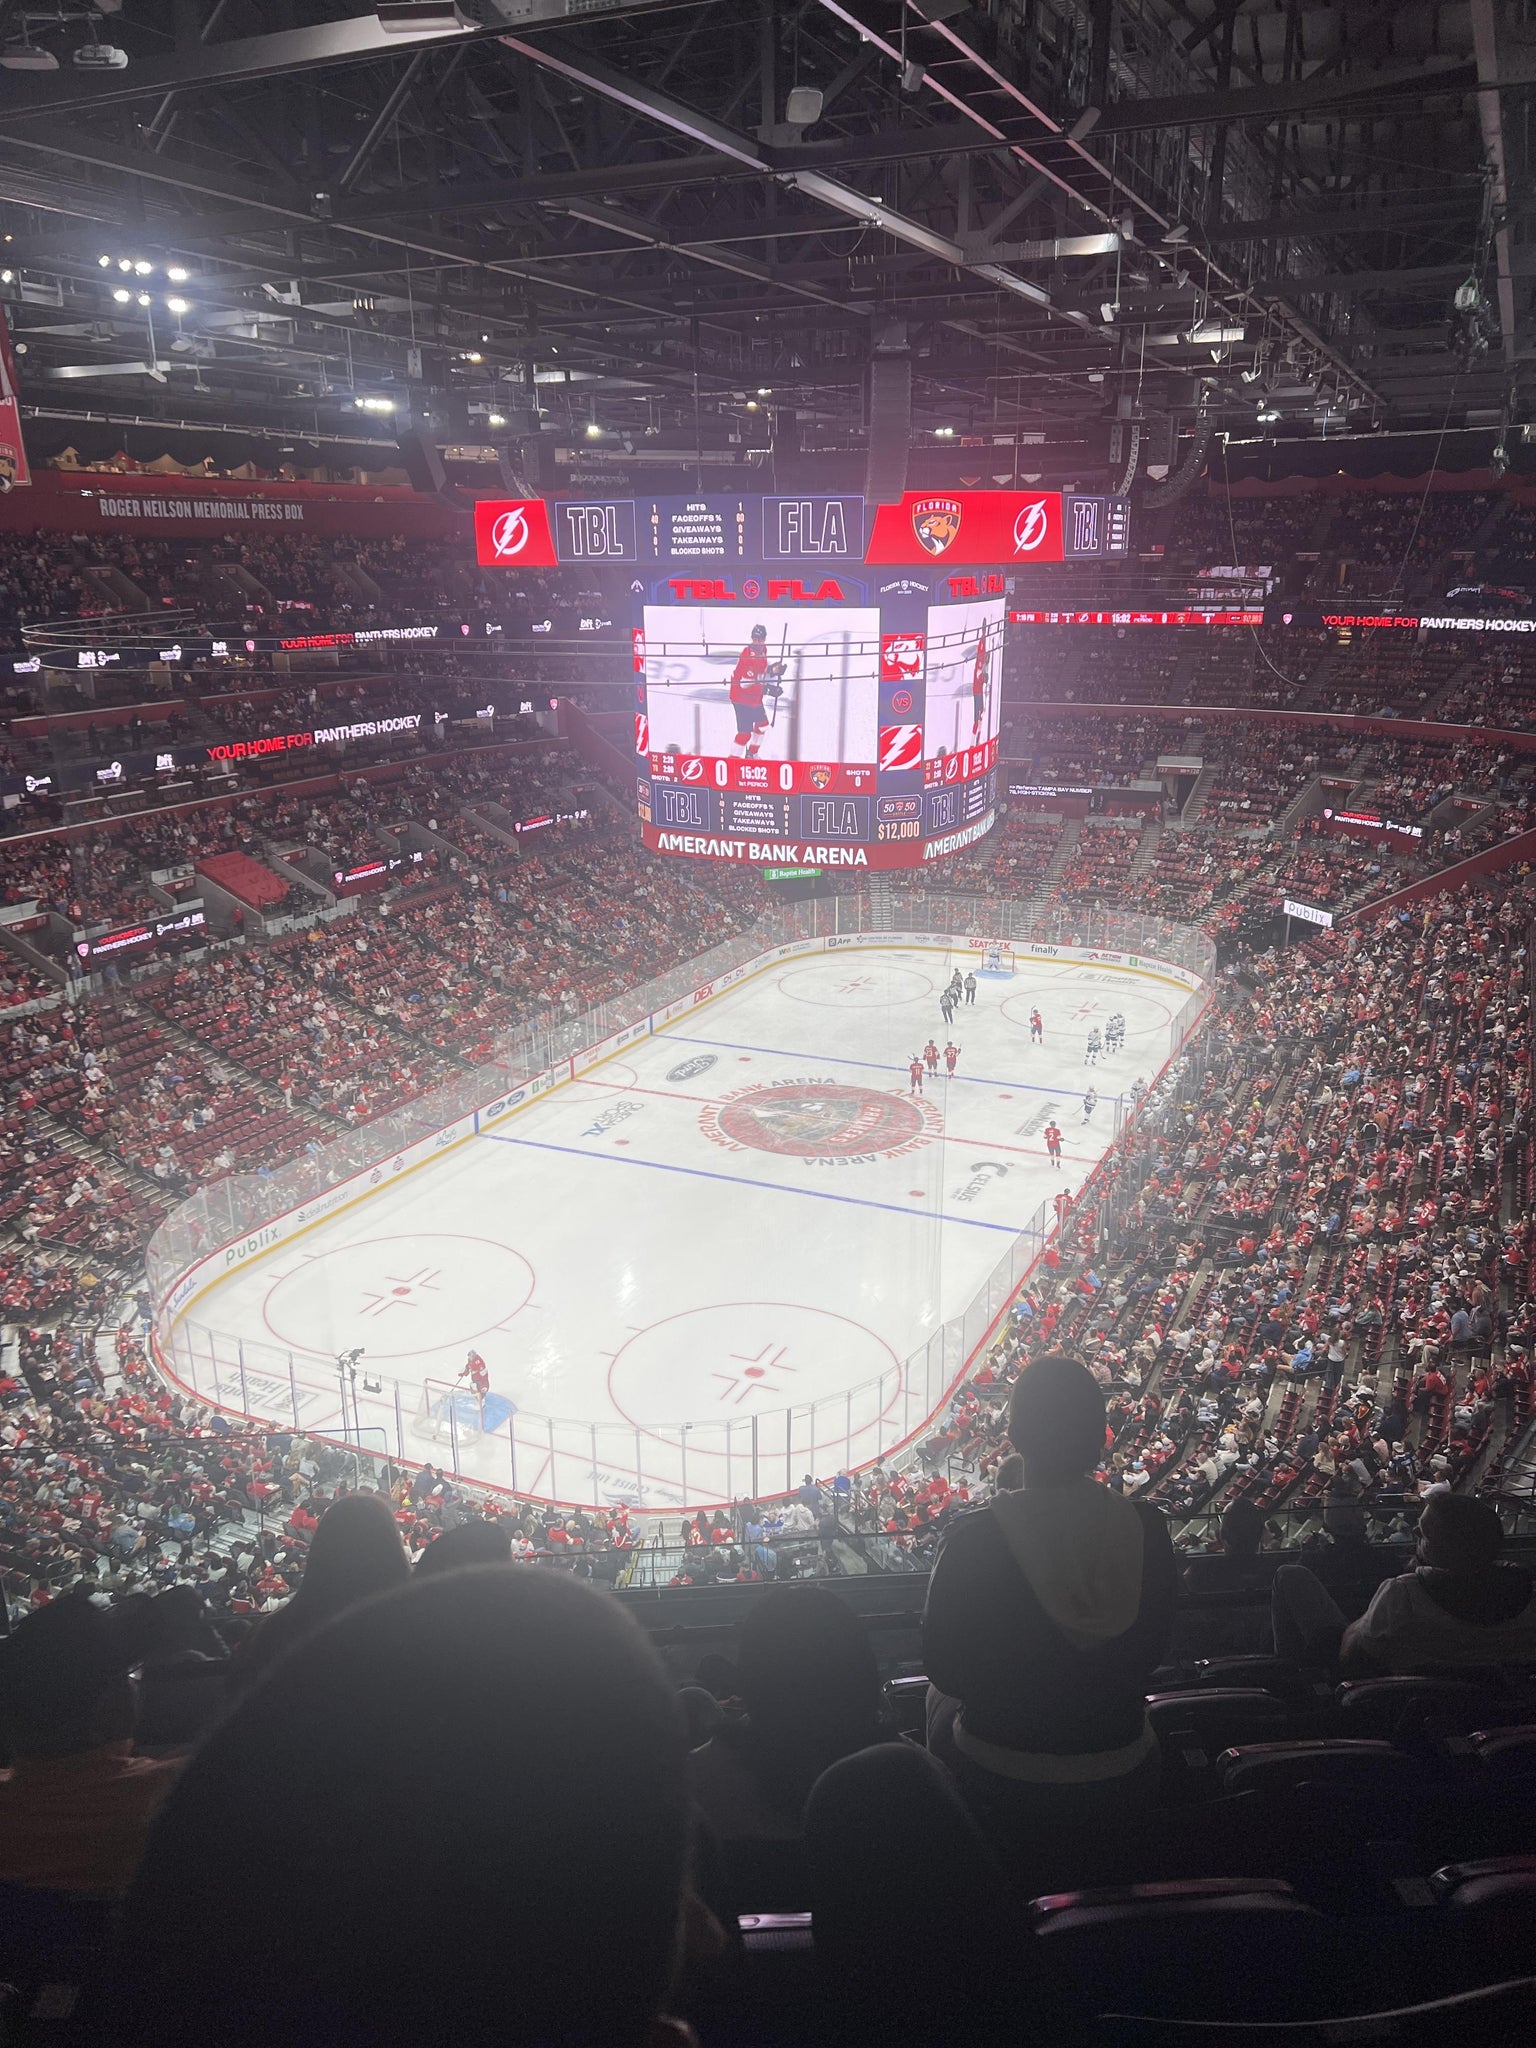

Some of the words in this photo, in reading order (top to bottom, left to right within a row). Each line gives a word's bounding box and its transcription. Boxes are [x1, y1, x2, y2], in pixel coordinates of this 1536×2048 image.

[101, 499, 141, 517] ROGER
[143, 500, 193, 518] NEILSON
[194, 502, 250, 519] MEMORIAL
[252, 504, 282, 520] PRESS
[285, 504, 304, 520] BOX
[686, 503, 707, 511] HITS
[917, 501, 957, 513] FLORIDA
[671, 514, 714, 522] FACEOFFS
[1073, 502, 1098, 550] TBL
[567, 506, 623, 555] TBL
[672, 525, 721, 533] GIVEAWAYS
[738, 524, 743, 533] 0
[779, 502, 847, 553] FLA
[671, 536, 723, 544] TAKEAWAYS
[738, 535, 743, 544] 0
[671, 547, 700, 555] BLOCKED
[701, 547, 724, 555] SHOTS
[738, 546, 743, 555] 0
[668, 579, 737, 599] TBL
[768, 579, 845, 600] FLA
[880, 581, 900, 593] FLORIDA
[909, 581, 929, 592] HOCKEY
[948, 576, 979, 597] TBL
[1097, 613, 1102, 622] 0
[1112, 613, 1130, 623] 15:02
[1162, 613, 1167, 623] 0
[1322, 616, 1355, 626] YOUR
[1357, 616, 1392, 627] HOME
[1394, 617, 1418, 627] FOR
[1420, 618, 1483, 630] PANTHERS
[1485, 619, 1536, 632] HOCKEY
[280, 637, 307, 648] YOUR
[308, 635, 334, 647] HOME
[336, 634, 354, 645] FOR
[355, 629, 400, 642] PANTHERS
[401, 627, 438, 638] HOCKEY
[896, 698, 909, 707] VS
[207, 742, 247, 761] YOUR
[247, 736, 286, 755] HOME
[287, 732, 313, 748] FOR
[314, 721, 376, 743] PANTHERS
[377, 715, 421, 734] HOCKEY
[716, 760, 728, 786] 0
[740, 765, 767, 780] 15:02
[963, 752, 969, 778] 0
[780, 763, 793, 790] 0
[855, 776, 861, 787] 0
[662, 790, 702, 825] TBL
[734, 810, 774, 818] GIVEAWAYS
[883, 803, 895, 813] 50
[904, 801, 916, 811] 50
[932, 792, 954, 828] TBL
[733, 818, 775, 826] TAKEAWAYS
[812, 802, 858, 834] FLA
[729, 825, 757, 833] BLOCKED
[878, 821, 920, 840] $12,000
[658, 833, 746, 858] AMERANT
[749, 842, 798, 862] BANK
[803, 847, 868, 866] ARENA
[924, 827, 973, 860] AMERANT
[93, 940, 126, 954] PANTHERS
[126, 932, 153, 945] HOCKEY
[968, 939, 1011, 951] SEATEK
[1031, 944, 1058, 956] finally
[694, 983, 713, 1004] DEX
[771, 1077, 836, 1087] ARENA
[718, 1083, 768, 1101] BANK
[886, 1088, 945, 1134] AMERANT
[698, 1105, 750, 1152] AMERANT
[829, 1104, 884, 1144] PANTHERS
[1049, 1133, 1054, 1141] 2
[884, 1136, 933, 1160] BANK
[804, 1154, 876, 1166] ARENA
[958, 1173, 991, 1202] CELSIUS
